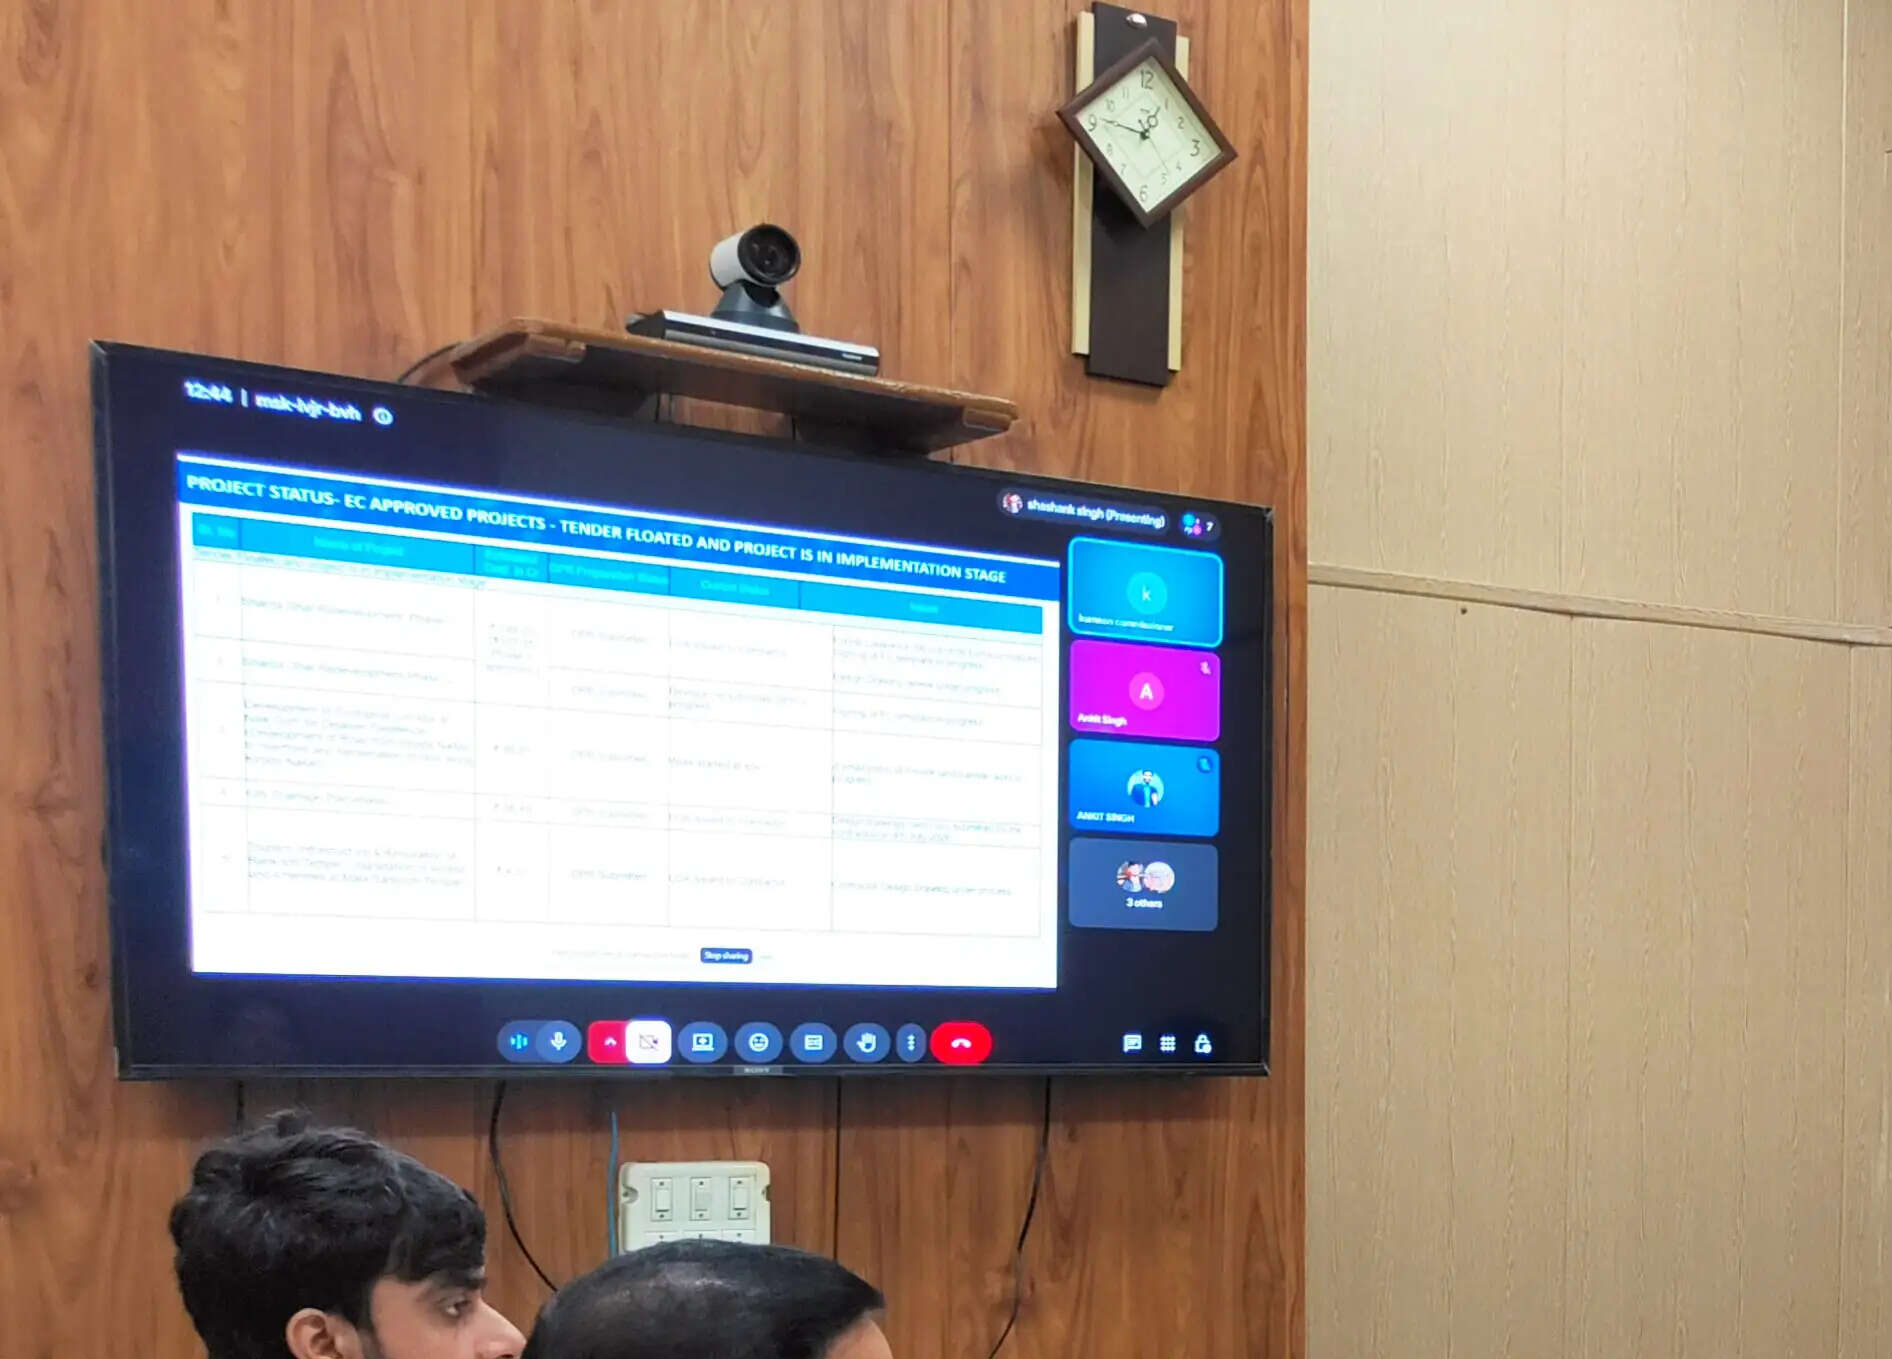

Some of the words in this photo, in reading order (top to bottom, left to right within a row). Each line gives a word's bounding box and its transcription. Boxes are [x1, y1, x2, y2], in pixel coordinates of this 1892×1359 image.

[1140, 69, 1155, 90] 12
[1086, 114, 1098, 133] 9
[1177, 116, 1185, 130] 2
[1189, 139, 1201, 157] 3
[1138, 184, 1148, 203] 6
[1027, 498, 1076, 517] shashank
[1106, 508, 1167, 530] (Presenting)
[187, 475, 265, 499] PROJECT
[269, 485, 340, 506] STATUS-
[345, 496, 365, 510] EC
[369, 498, 463, 521] APPROVED
[467, 509, 546, 531] PROJECTS
[561, 520, 622, 541] TENDER
[626, 528, 693, 548] FLOATED
[697, 537, 731, 553] AND
[734, 540, 798, 561] PROJECT
[801, 549, 813, 562] IS
[817, 550, 833, 564] IN
[836, 552, 962, 580] IMPLEMENTATION
[965, 567, 1007, 584] STAGE
[1206, 521, 1214, 532] 7
[1139, 683, 1154, 700] A
